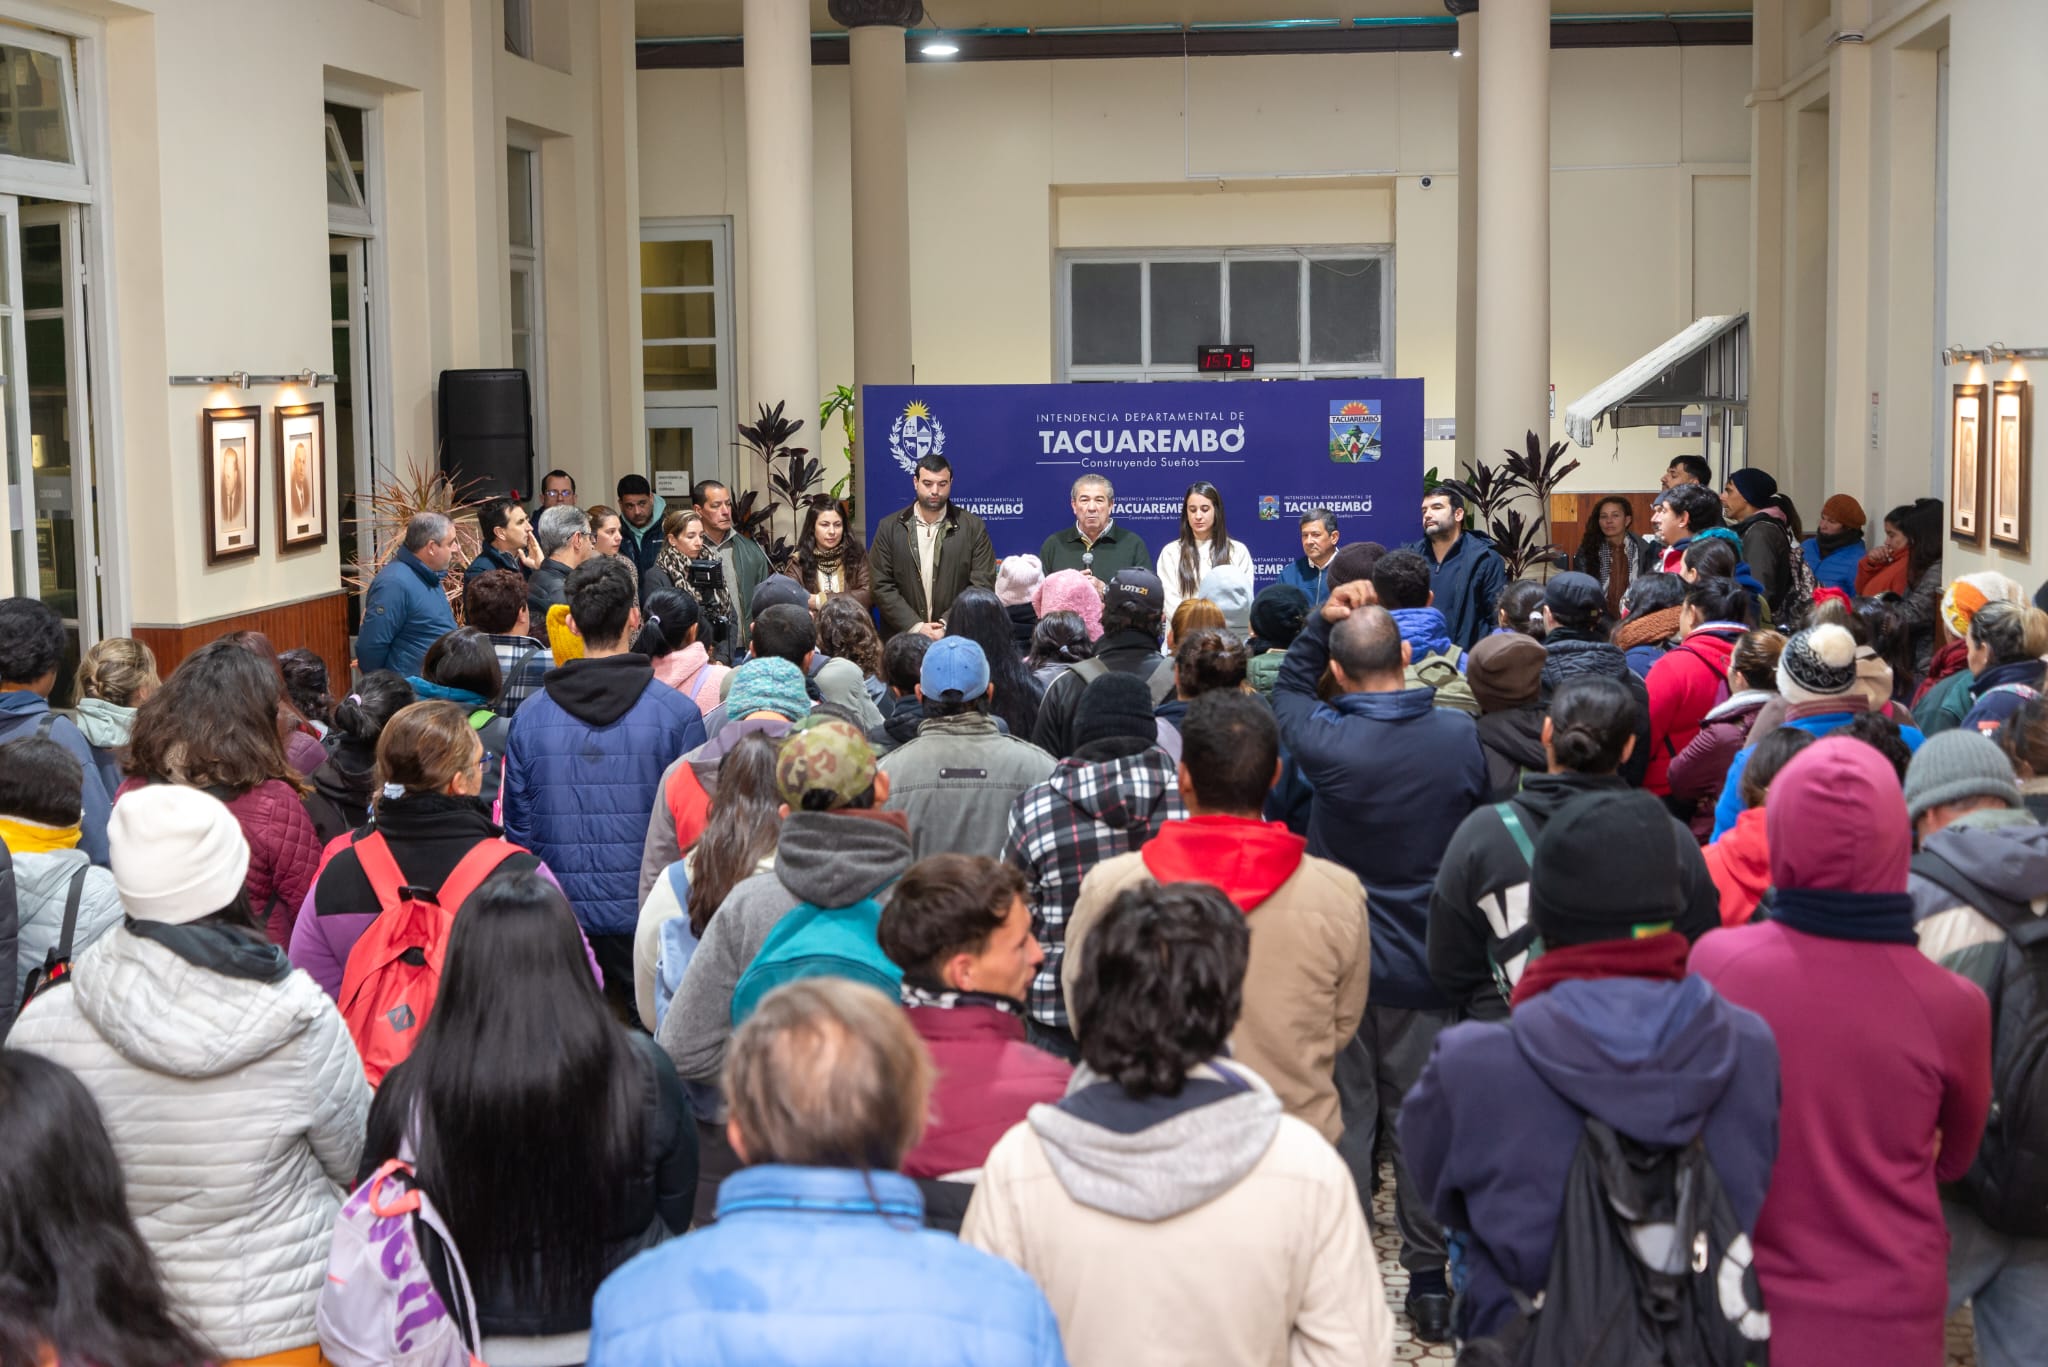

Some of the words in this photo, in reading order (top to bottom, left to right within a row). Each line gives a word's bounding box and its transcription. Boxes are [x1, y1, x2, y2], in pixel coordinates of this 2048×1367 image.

[1036, 413, 1119, 423] INTENDENCIA
[1125, 411, 1225, 422] DEPARTAMENTAL
[1230, 411, 1245, 421] DE
[1331, 415, 1379, 423] TACUAREMBÓ
[1081, 457, 1157, 470] Construyendo
[1161, 457, 1200, 468] Sueños
